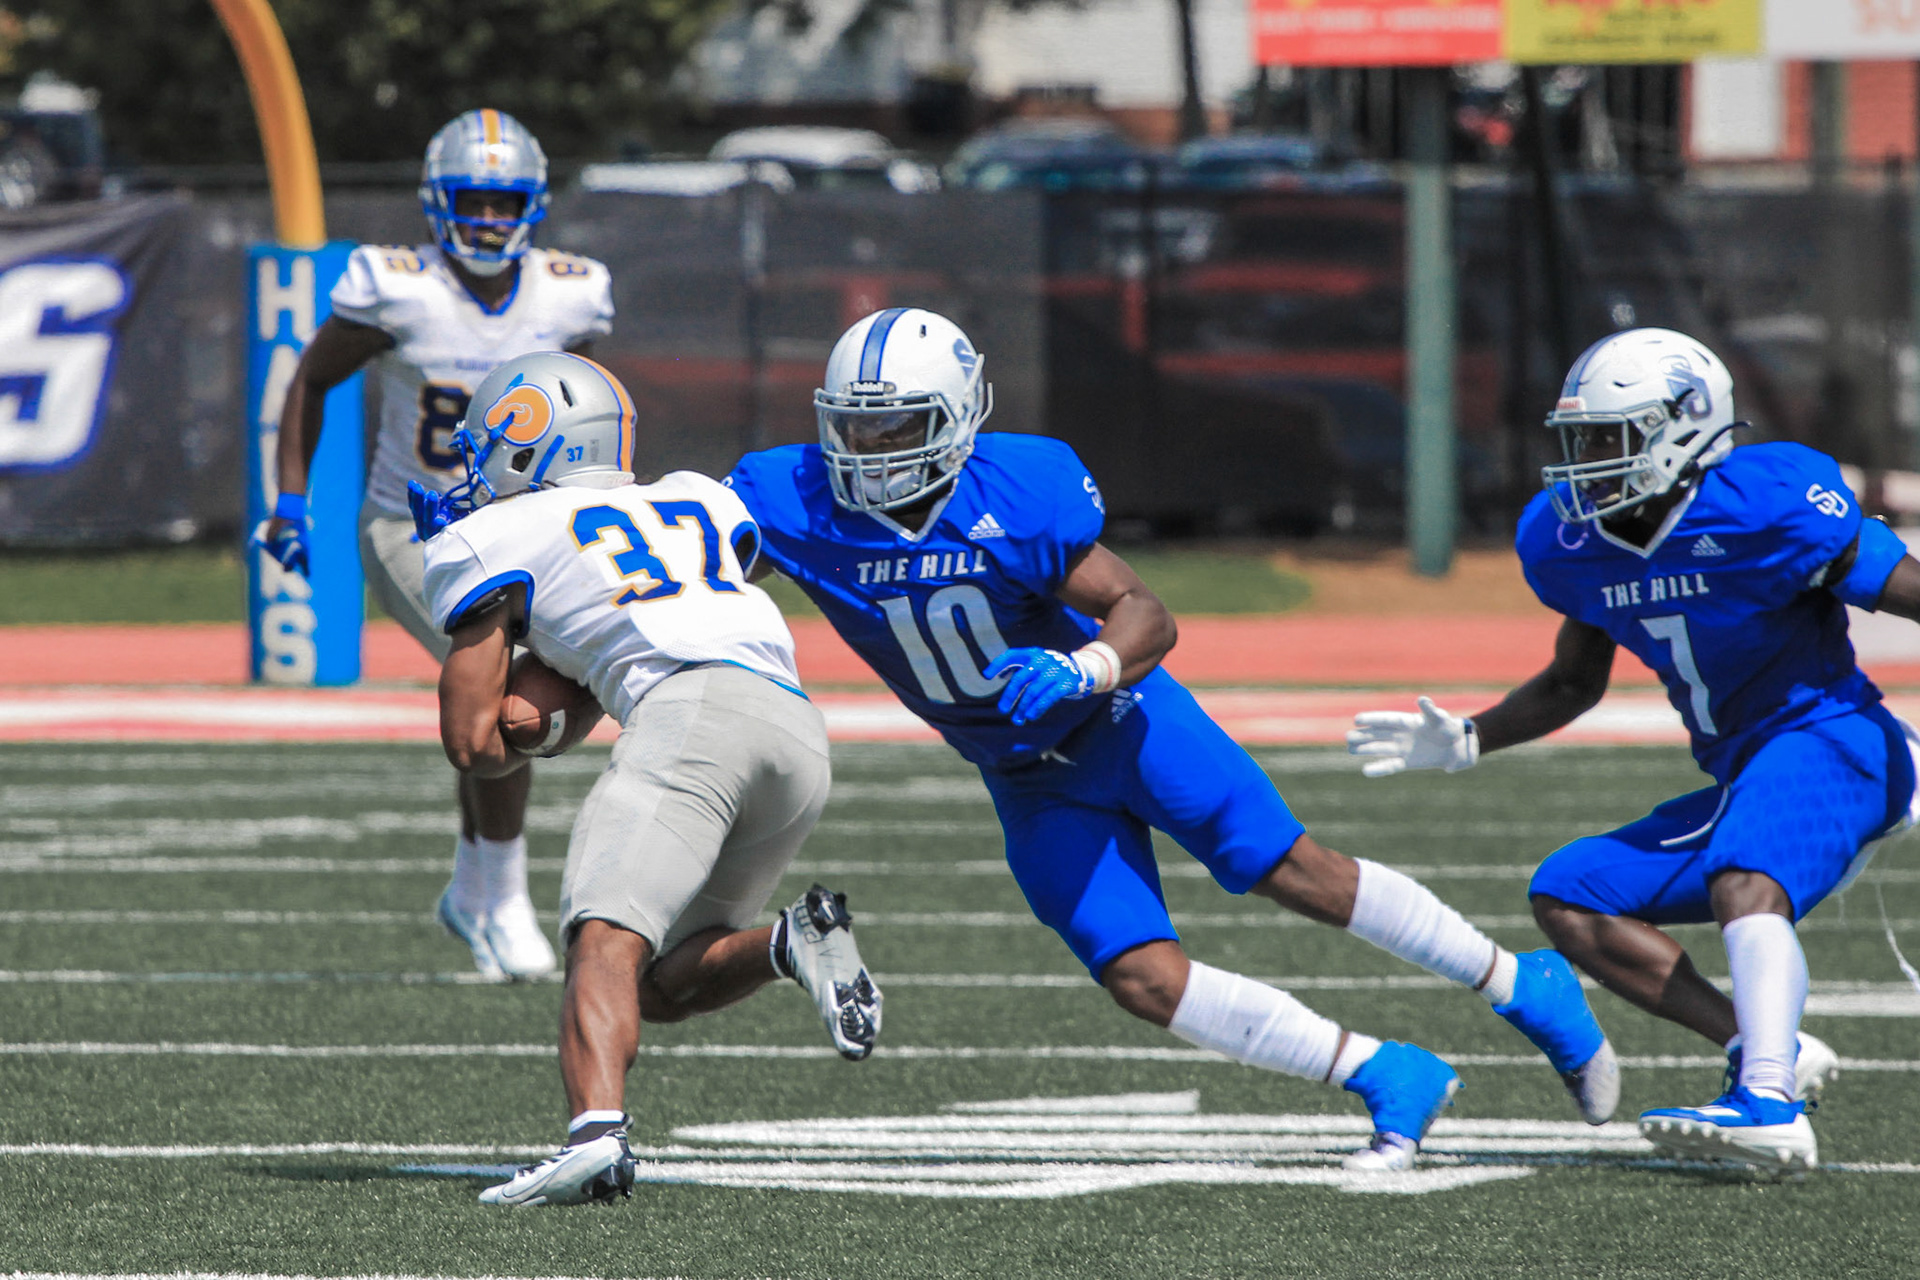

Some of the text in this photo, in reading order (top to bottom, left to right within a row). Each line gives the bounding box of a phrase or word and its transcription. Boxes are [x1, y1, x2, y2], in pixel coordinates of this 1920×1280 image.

[257, 256, 318, 684] HKS
[566, 446, 584, 463] 37
[567, 499, 747, 609] 37
[857, 550, 987, 585] THE HILL
[1601, 573, 1710, 608] THE HILL
[876, 584, 1014, 704] 10
[1639, 614, 1719, 737] 7
